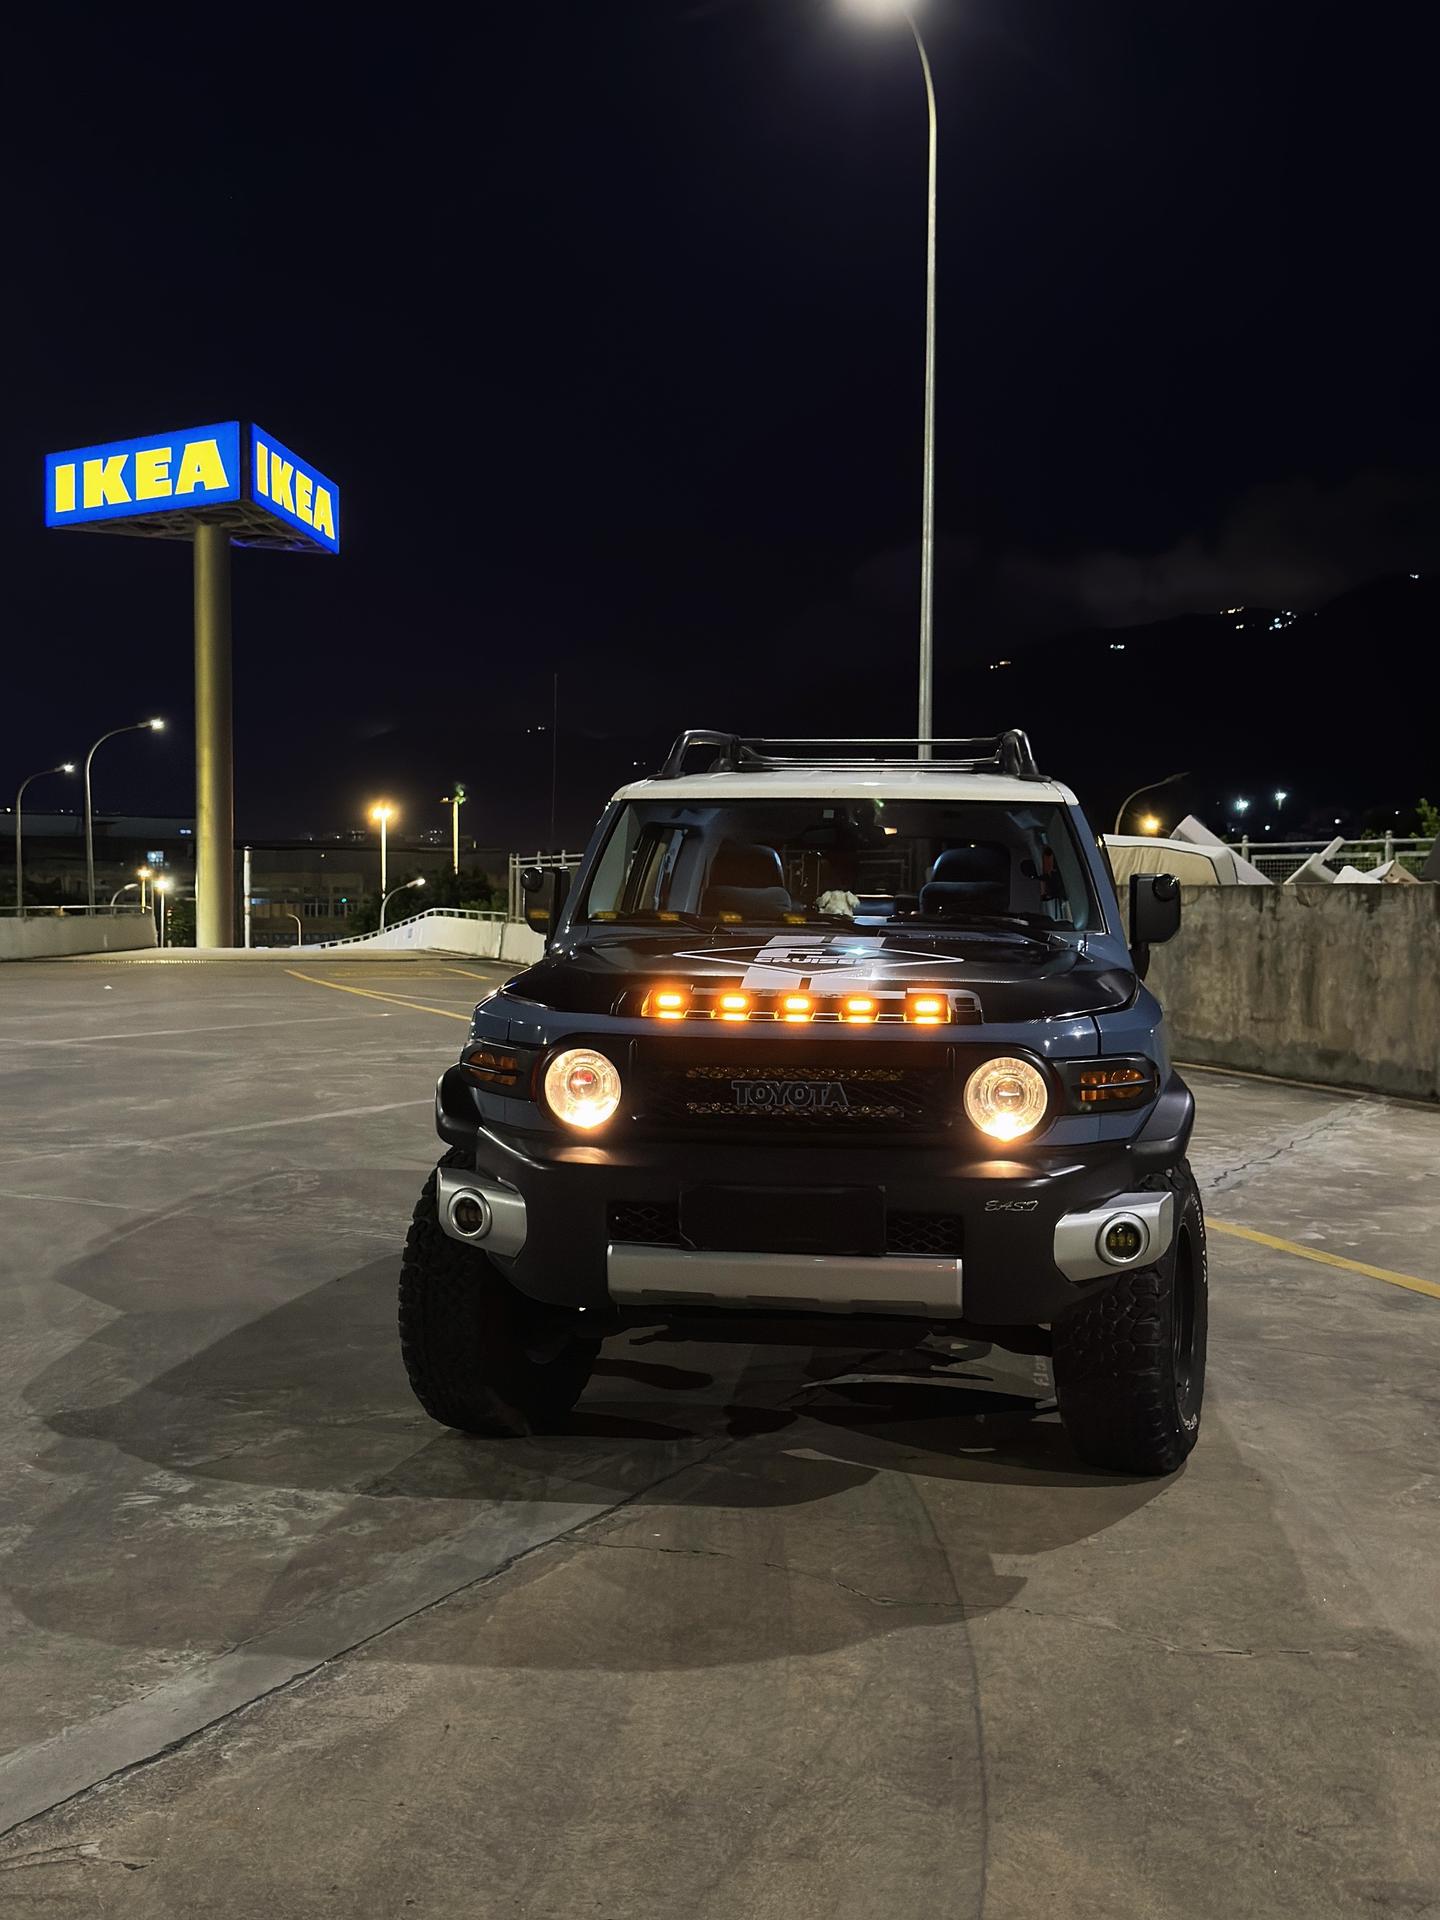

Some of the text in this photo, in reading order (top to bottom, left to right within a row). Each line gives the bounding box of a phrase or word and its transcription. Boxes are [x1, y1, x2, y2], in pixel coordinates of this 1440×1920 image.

[55, 439, 230, 513] IKEA
[256, 441, 336, 541] IKEA
[731, 1080, 849, 1108] TOYOTA
